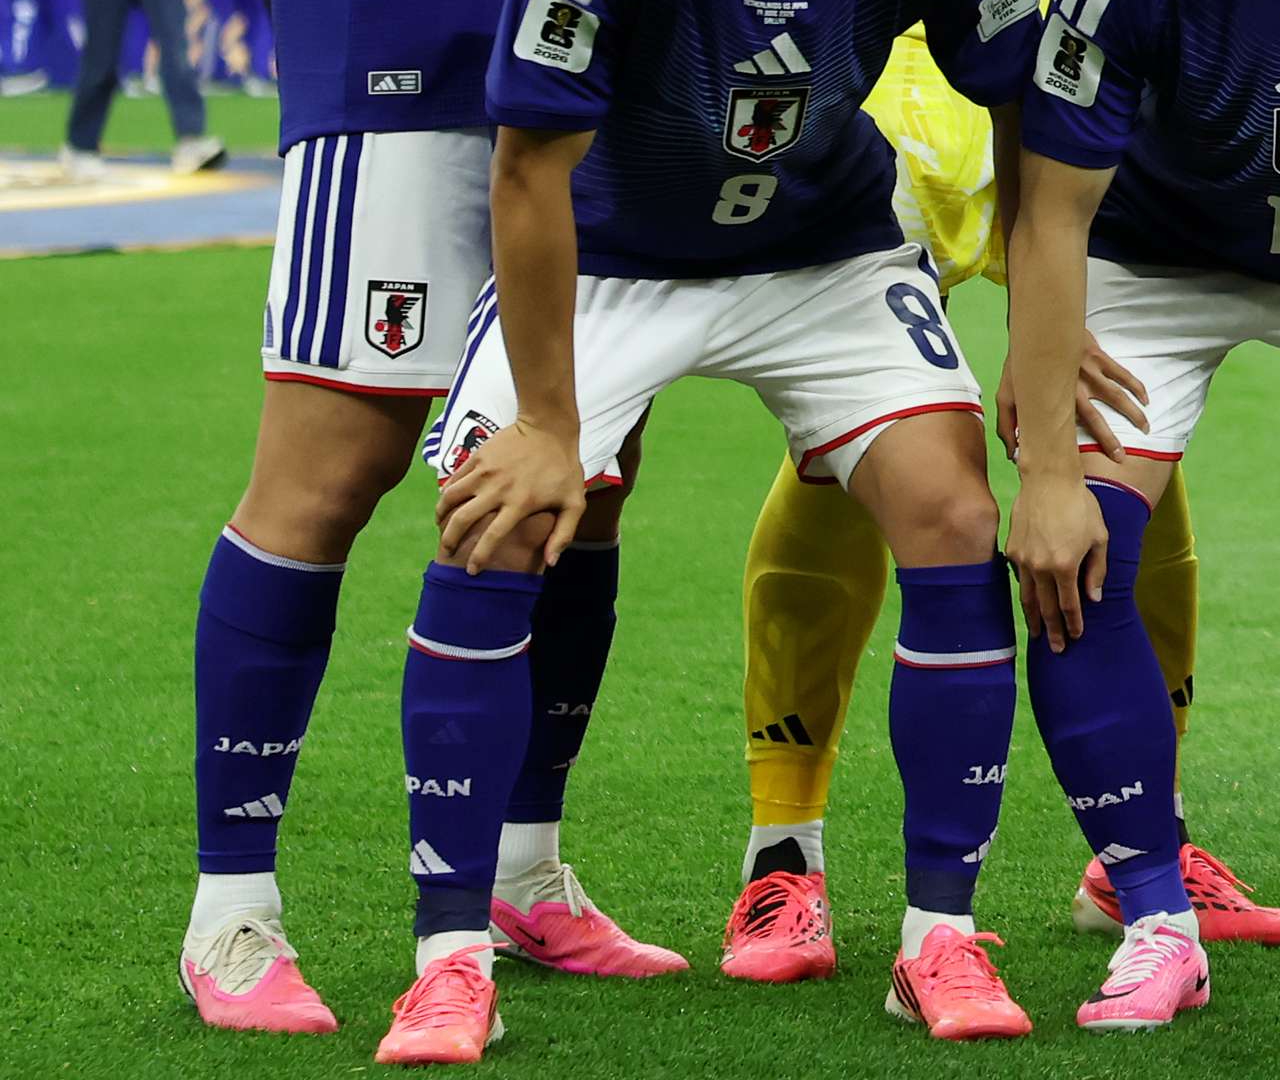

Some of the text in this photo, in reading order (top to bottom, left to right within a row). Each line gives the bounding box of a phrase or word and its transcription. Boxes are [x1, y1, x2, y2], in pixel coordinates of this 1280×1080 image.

[533, 48, 568, 63] 2026
[1060, 63, 1075, 77] FIFA
[1045, 77, 1077, 96] 2026
[712, 174, 778, 225] 8
[381, 282, 415, 290] JAPAN
[885, 282, 959, 370] 8
[405, 774, 472, 798] PAN
